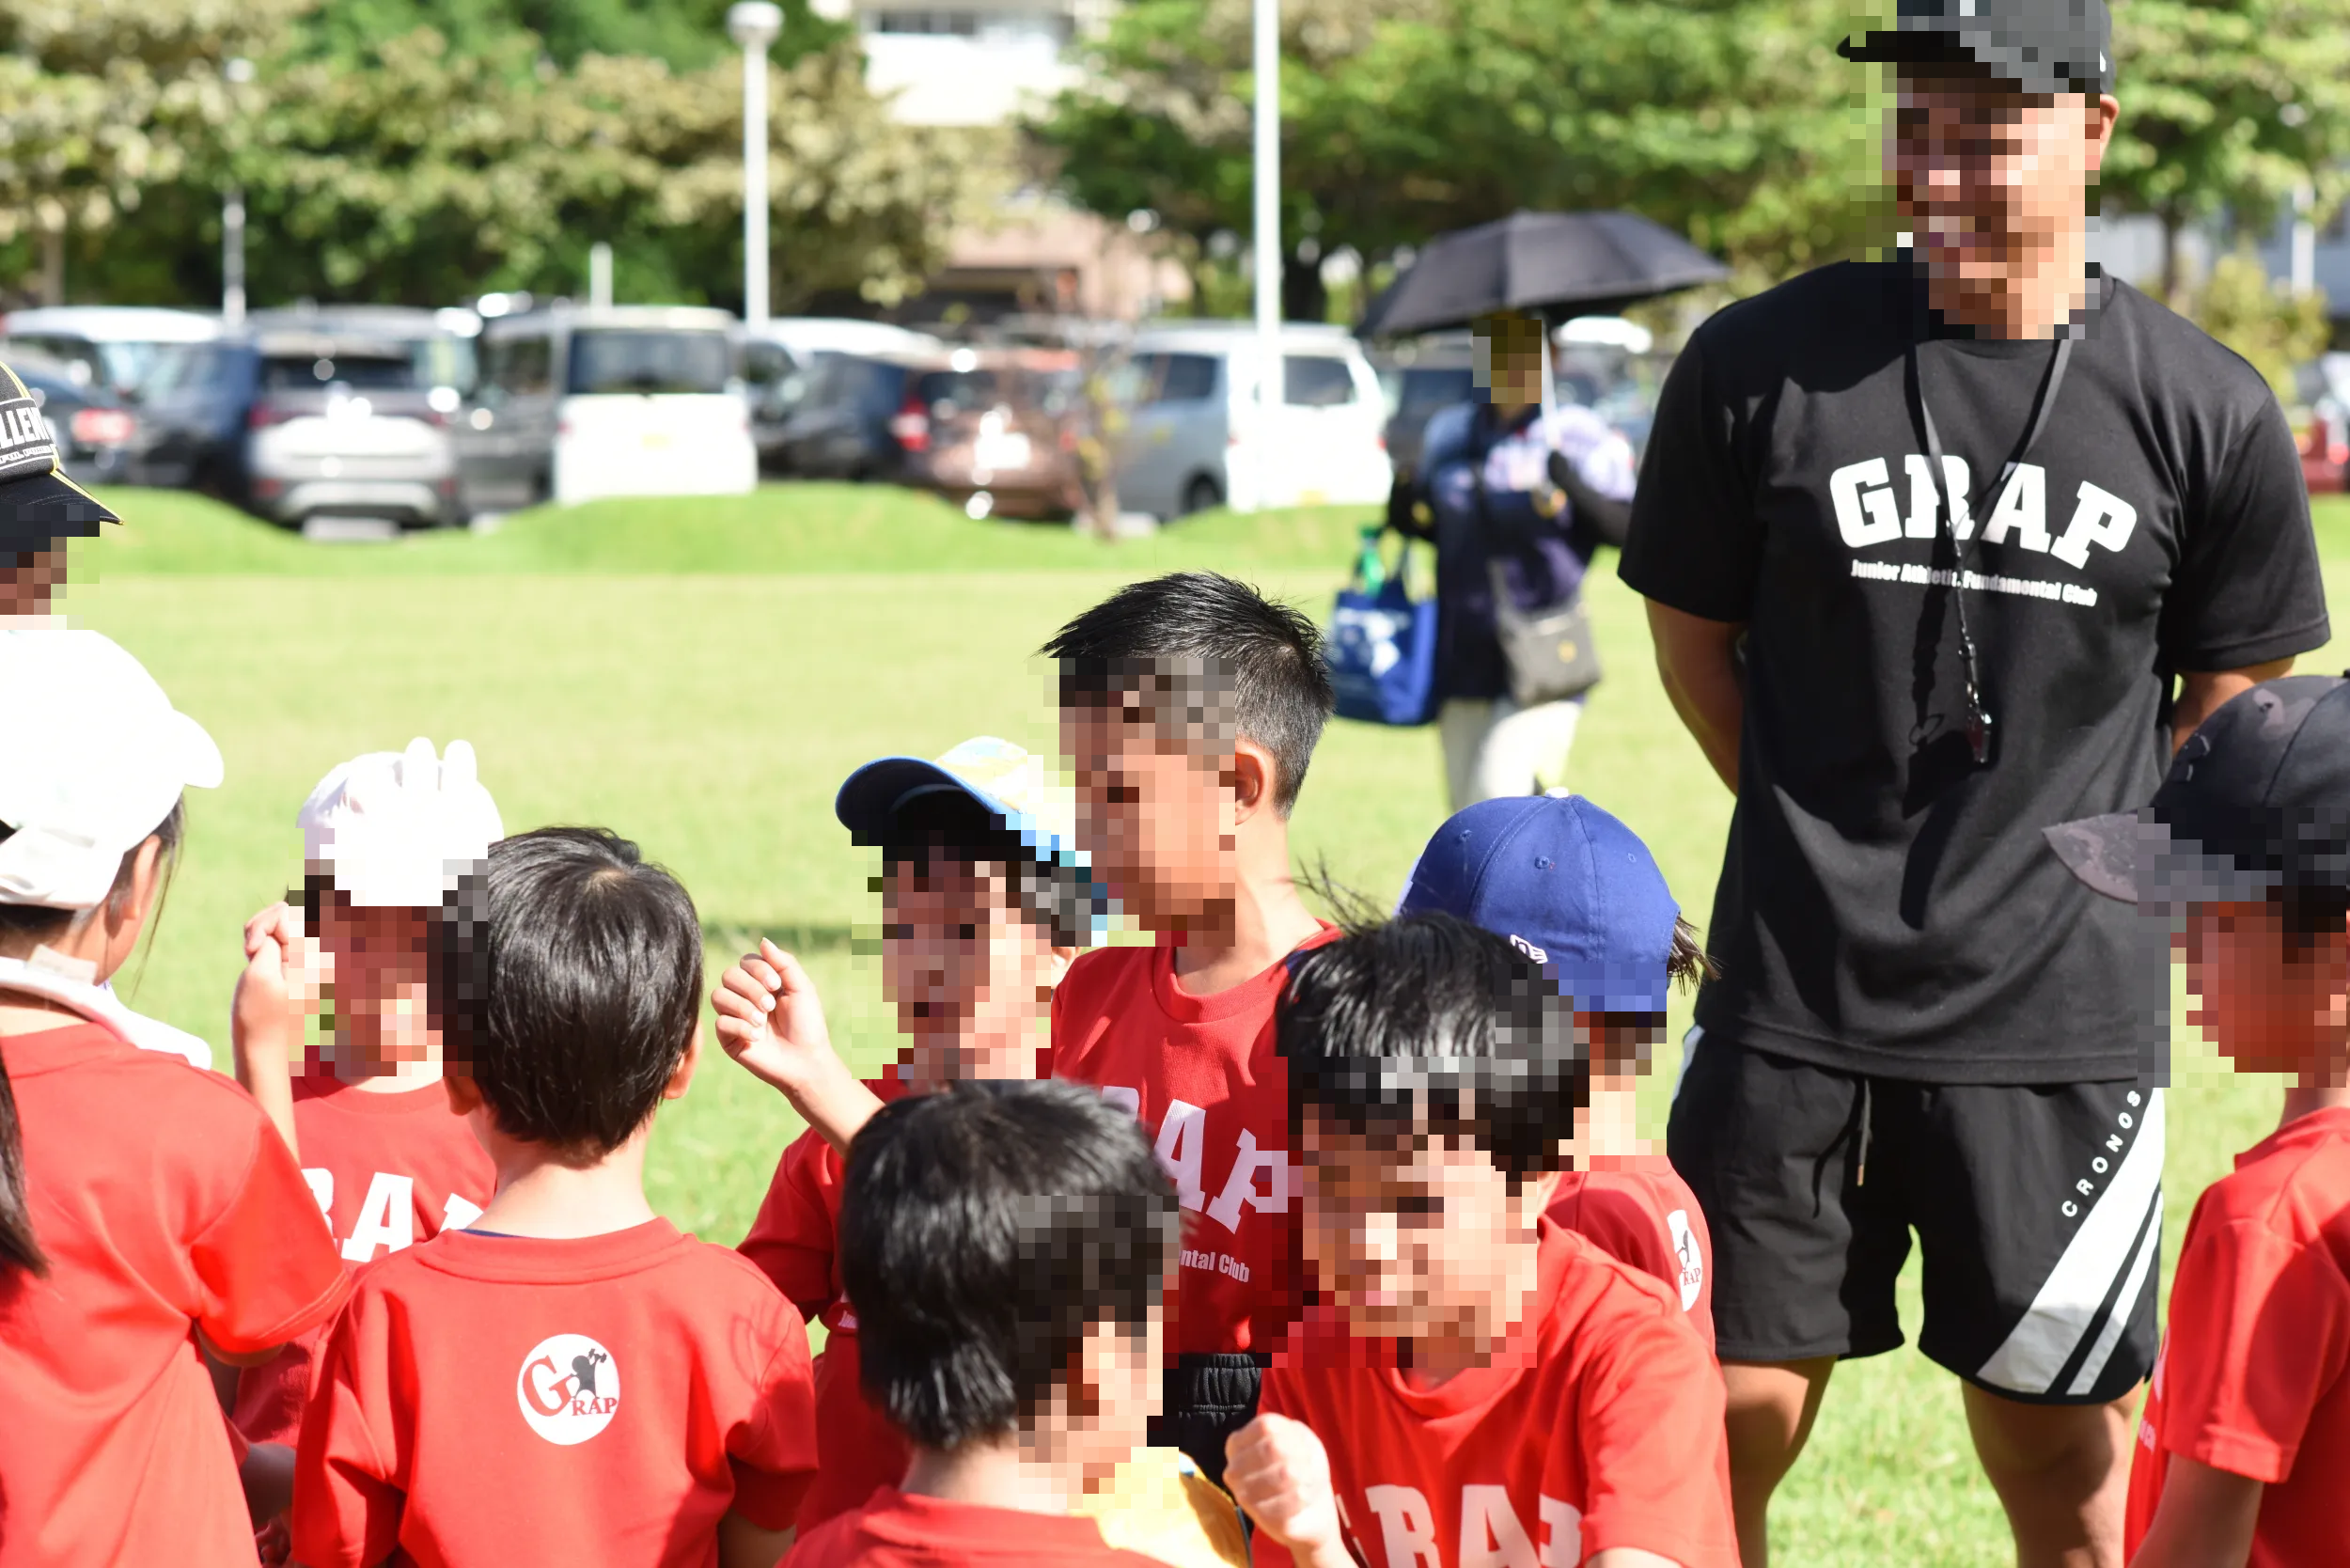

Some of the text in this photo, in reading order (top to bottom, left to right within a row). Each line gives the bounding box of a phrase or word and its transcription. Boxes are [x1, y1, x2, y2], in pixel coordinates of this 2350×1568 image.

[1830, 454, 2138, 570] GRAP
[1850, 558, 1901, 581] Junior
[1963, 570, 2062, 601] Fundamental
[2062, 583, 2098, 606] Club
[2061, 1090, 2141, 1217] CRONOS
[1179, 1249, 1250, 1283] ntal Club
